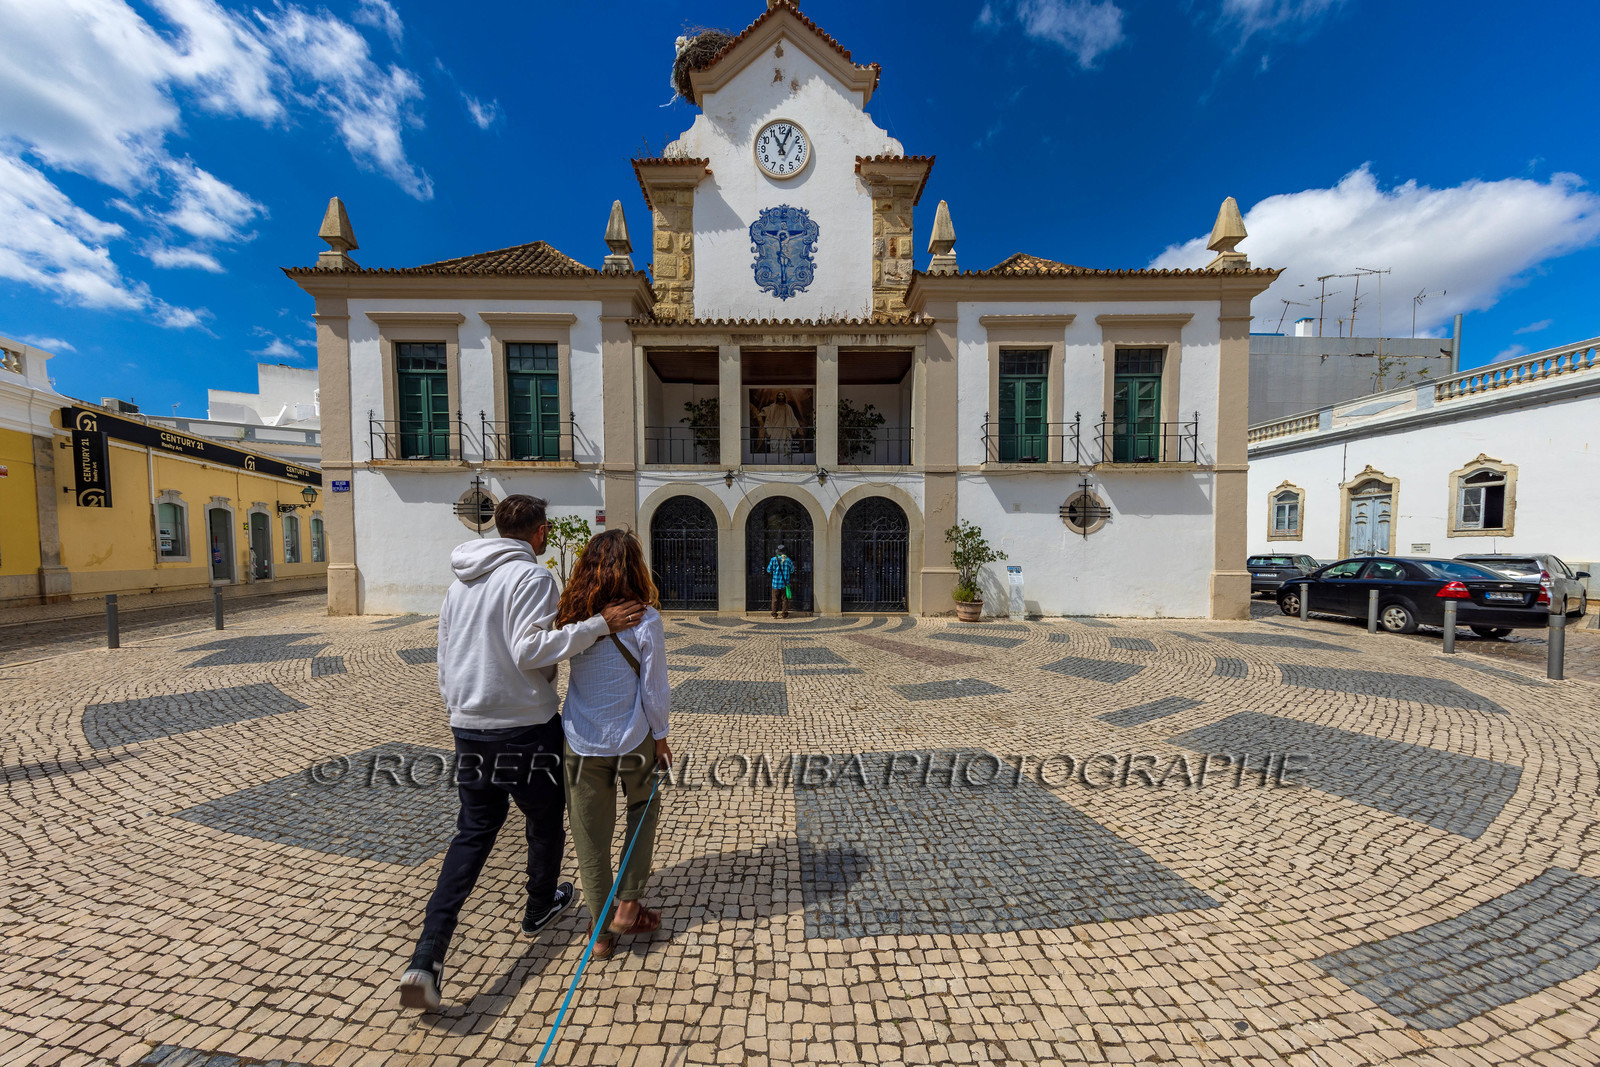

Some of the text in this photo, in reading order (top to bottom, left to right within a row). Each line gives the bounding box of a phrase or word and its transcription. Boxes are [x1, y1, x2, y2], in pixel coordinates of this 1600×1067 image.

[770, 129, 775, 137] 11
[778, 126, 786, 135] 12
[763, 136, 769, 144] 10
[795, 136, 800, 144] 2
[761, 145, 766, 153] 9
[798, 145, 802, 153] 3
[764, 154, 769, 162] 8
[795, 154, 800, 162] 4
[771, 162, 776, 170] 7
[779, 164, 784, 172] 6
[789, 162, 793, 170] 5
[160, 432, 204, 450] CENTURY 21
[81, 438, 91, 482] CENTURY 21
[88, 495, 105, 507] 21
